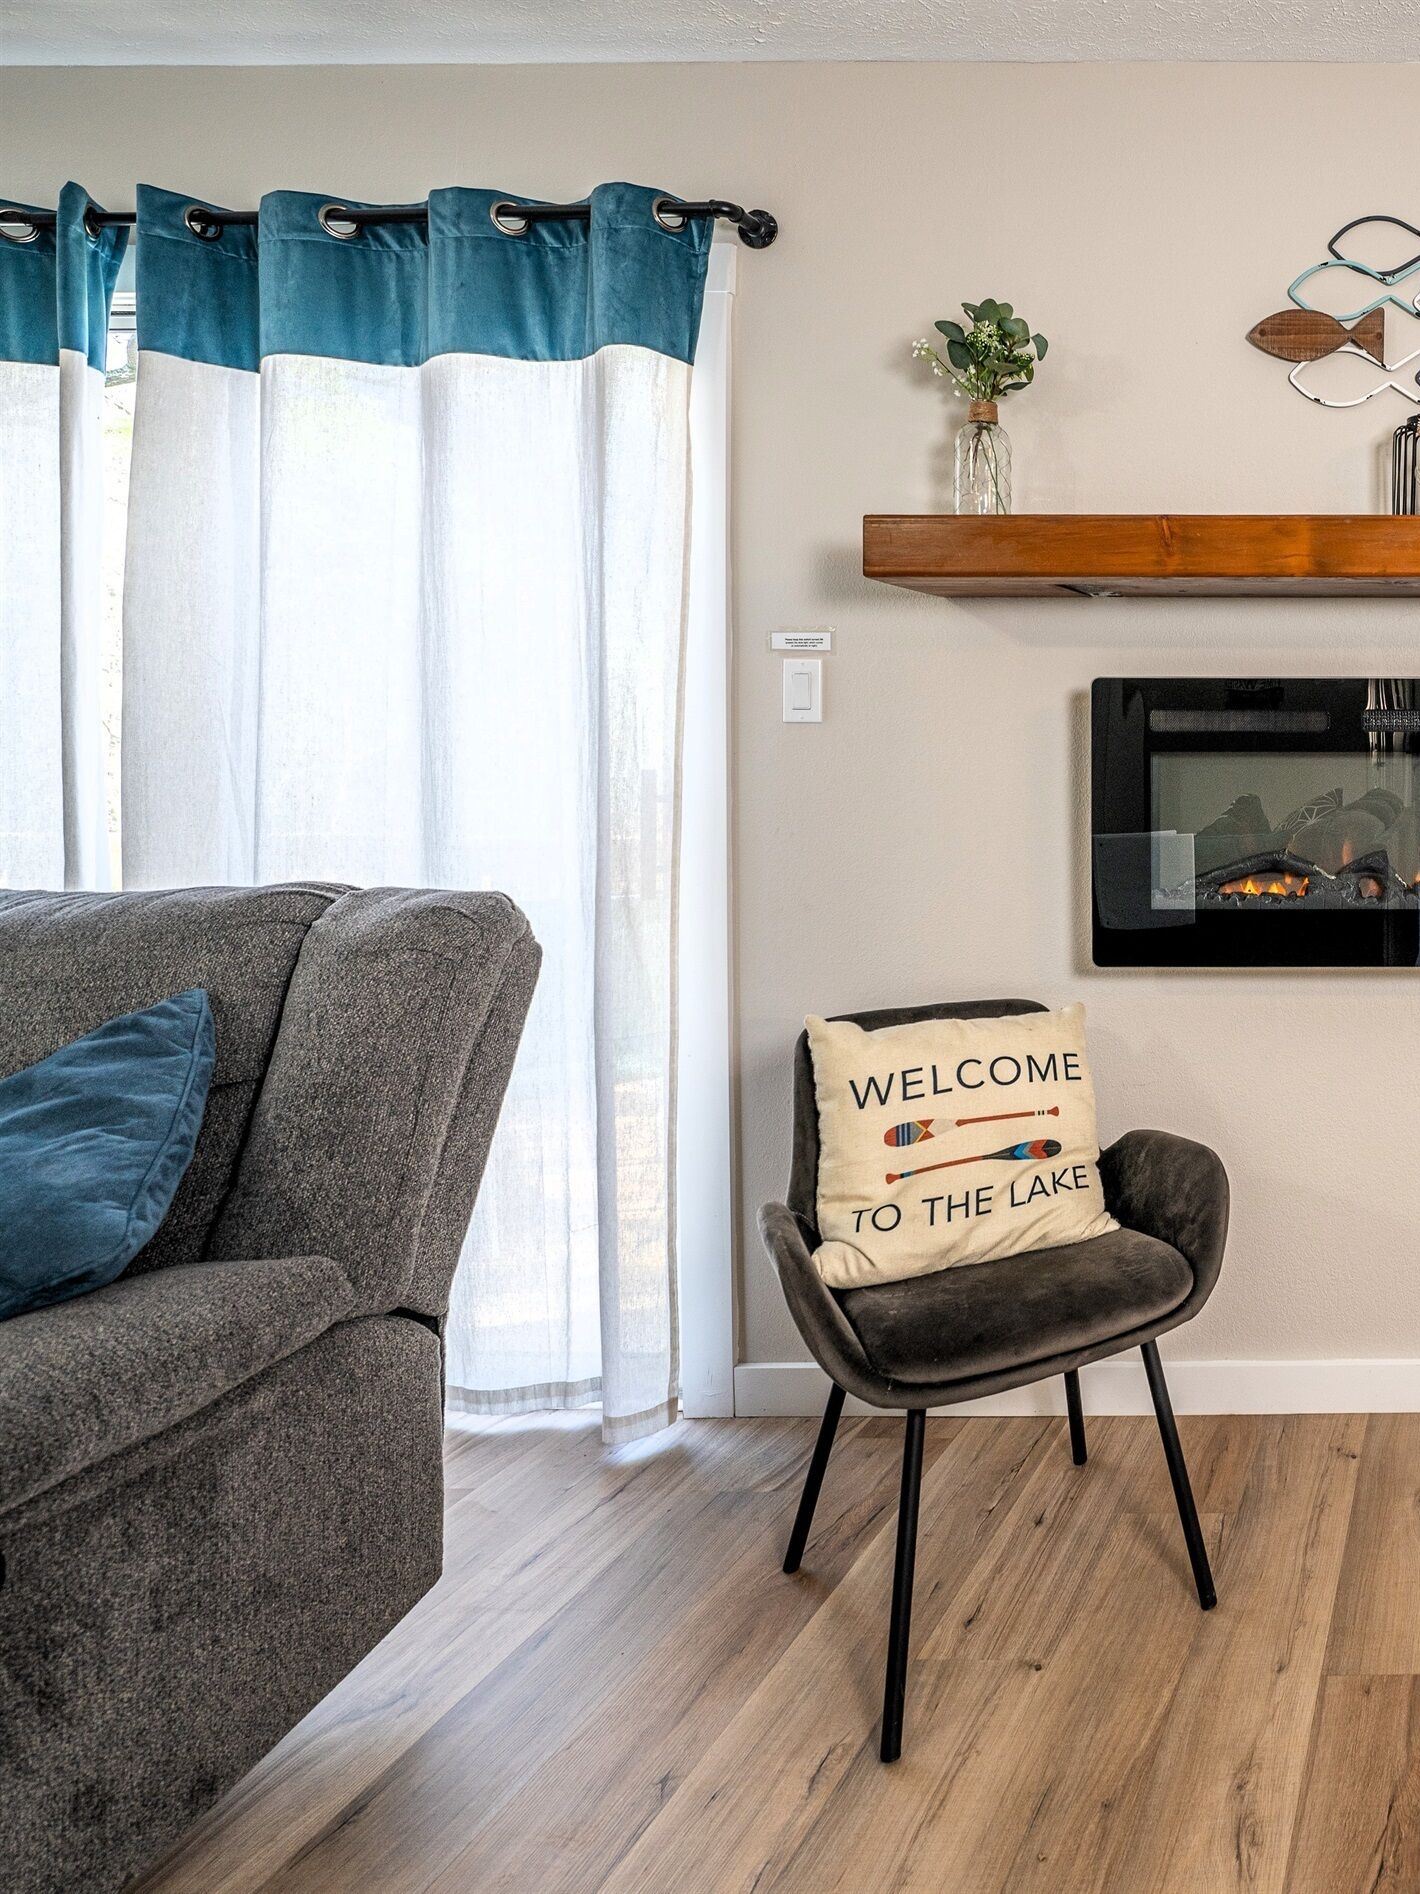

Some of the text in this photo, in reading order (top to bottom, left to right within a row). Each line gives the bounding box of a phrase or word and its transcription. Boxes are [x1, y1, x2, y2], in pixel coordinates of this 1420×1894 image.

[849, 1053, 1082, 1110] WELCOME
[852, 1165, 1090, 1233] TO THE LAKE
